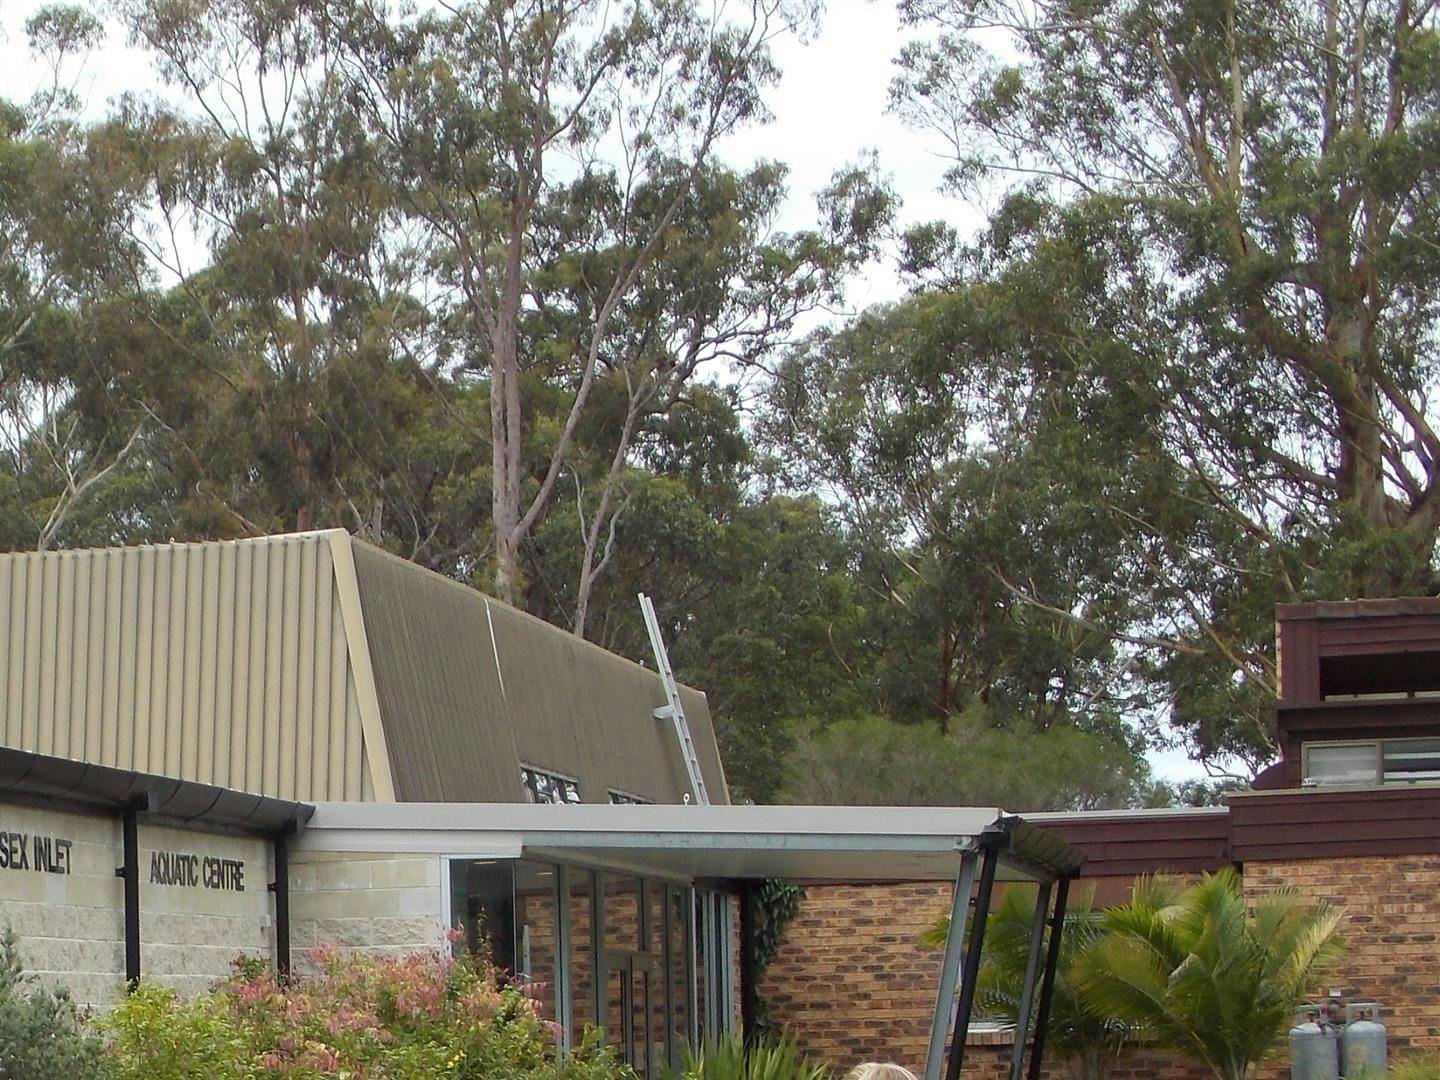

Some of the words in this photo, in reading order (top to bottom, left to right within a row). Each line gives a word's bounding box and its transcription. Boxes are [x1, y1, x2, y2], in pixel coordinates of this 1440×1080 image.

[33, 836, 73, 875] INLET
[150, 851, 199, 888] AQUATIC
[202, 856, 246, 892] CENTRE
